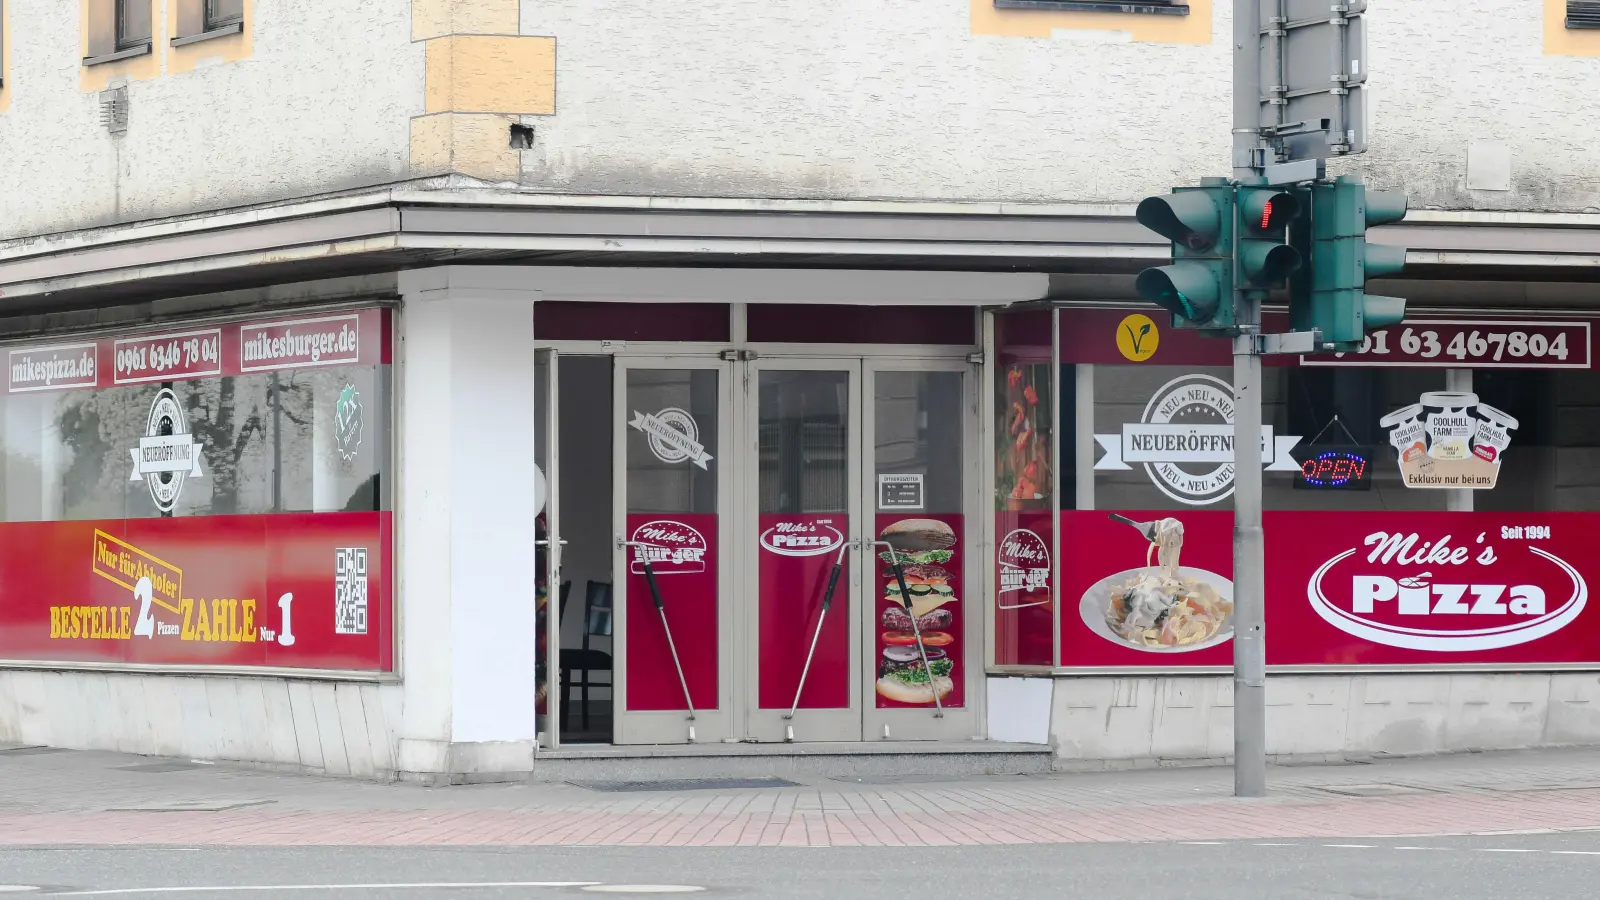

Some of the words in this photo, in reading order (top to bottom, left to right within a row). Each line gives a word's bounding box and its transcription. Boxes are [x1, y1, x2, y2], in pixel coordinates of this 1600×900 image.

[244, 323, 356, 362] mikesburger.de
[1400, 328, 1441, 358] 63
[1446, 330, 1569, 361] 467804
[117, 345, 147, 376] 0961
[149, 339, 181, 372] 6346
[183, 337, 199, 369] 78
[201, 335, 218, 364] 04
[12, 351, 95, 386] mikespizza.de
[1160, 396, 1180, 418] NEU
[1187, 389, 1209, 401] NEU
[1215, 397, 1234, 419] NEU
[1394, 423, 1422, 438] COOLHULL
[1433, 417, 1468, 427] COOLHULL
[1433, 427, 1452, 437] FARM
[1479, 423, 1505, 441] COOLHULL
[142, 440, 190, 463] NEUERÖFFNUNG
[1160, 463, 1180, 485] NEU
[1187, 480, 1208, 491] NEU
[1215, 463, 1235, 486] NEU
[1301, 459, 1367, 480] OPEN
[1409, 473, 1442, 484] Exklusiv
[1444, 475, 1459, 484] nur
[1461, 474, 1474, 484] bei
[1476, 475, 1491, 484] uns
[642, 527, 697, 544] Mike's
[776, 521, 816, 532] Mike's
[1501, 525, 1523, 539] Seit
[1523, 525, 1551, 539] 1994
[772, 533, 831, 547] Pizza
[1005, 541, 1043, 560] Mike's
[1364, 531, 1498, 566] Mike's
[97, 540, 118, 569] Nur
[1000, 565, 1049, 592] Burger
[1353, 571, 1546, 615] Pizza
[50, 605, 131, 640] BESTELLE
[133, 576, 155, 640] 2
[157, 620, 180, 635] Pizzen
[180, 597, 257, 643] ZAHLE
[260, 626, 276, 642] Nur
[277, 592, 296, 646] 1
